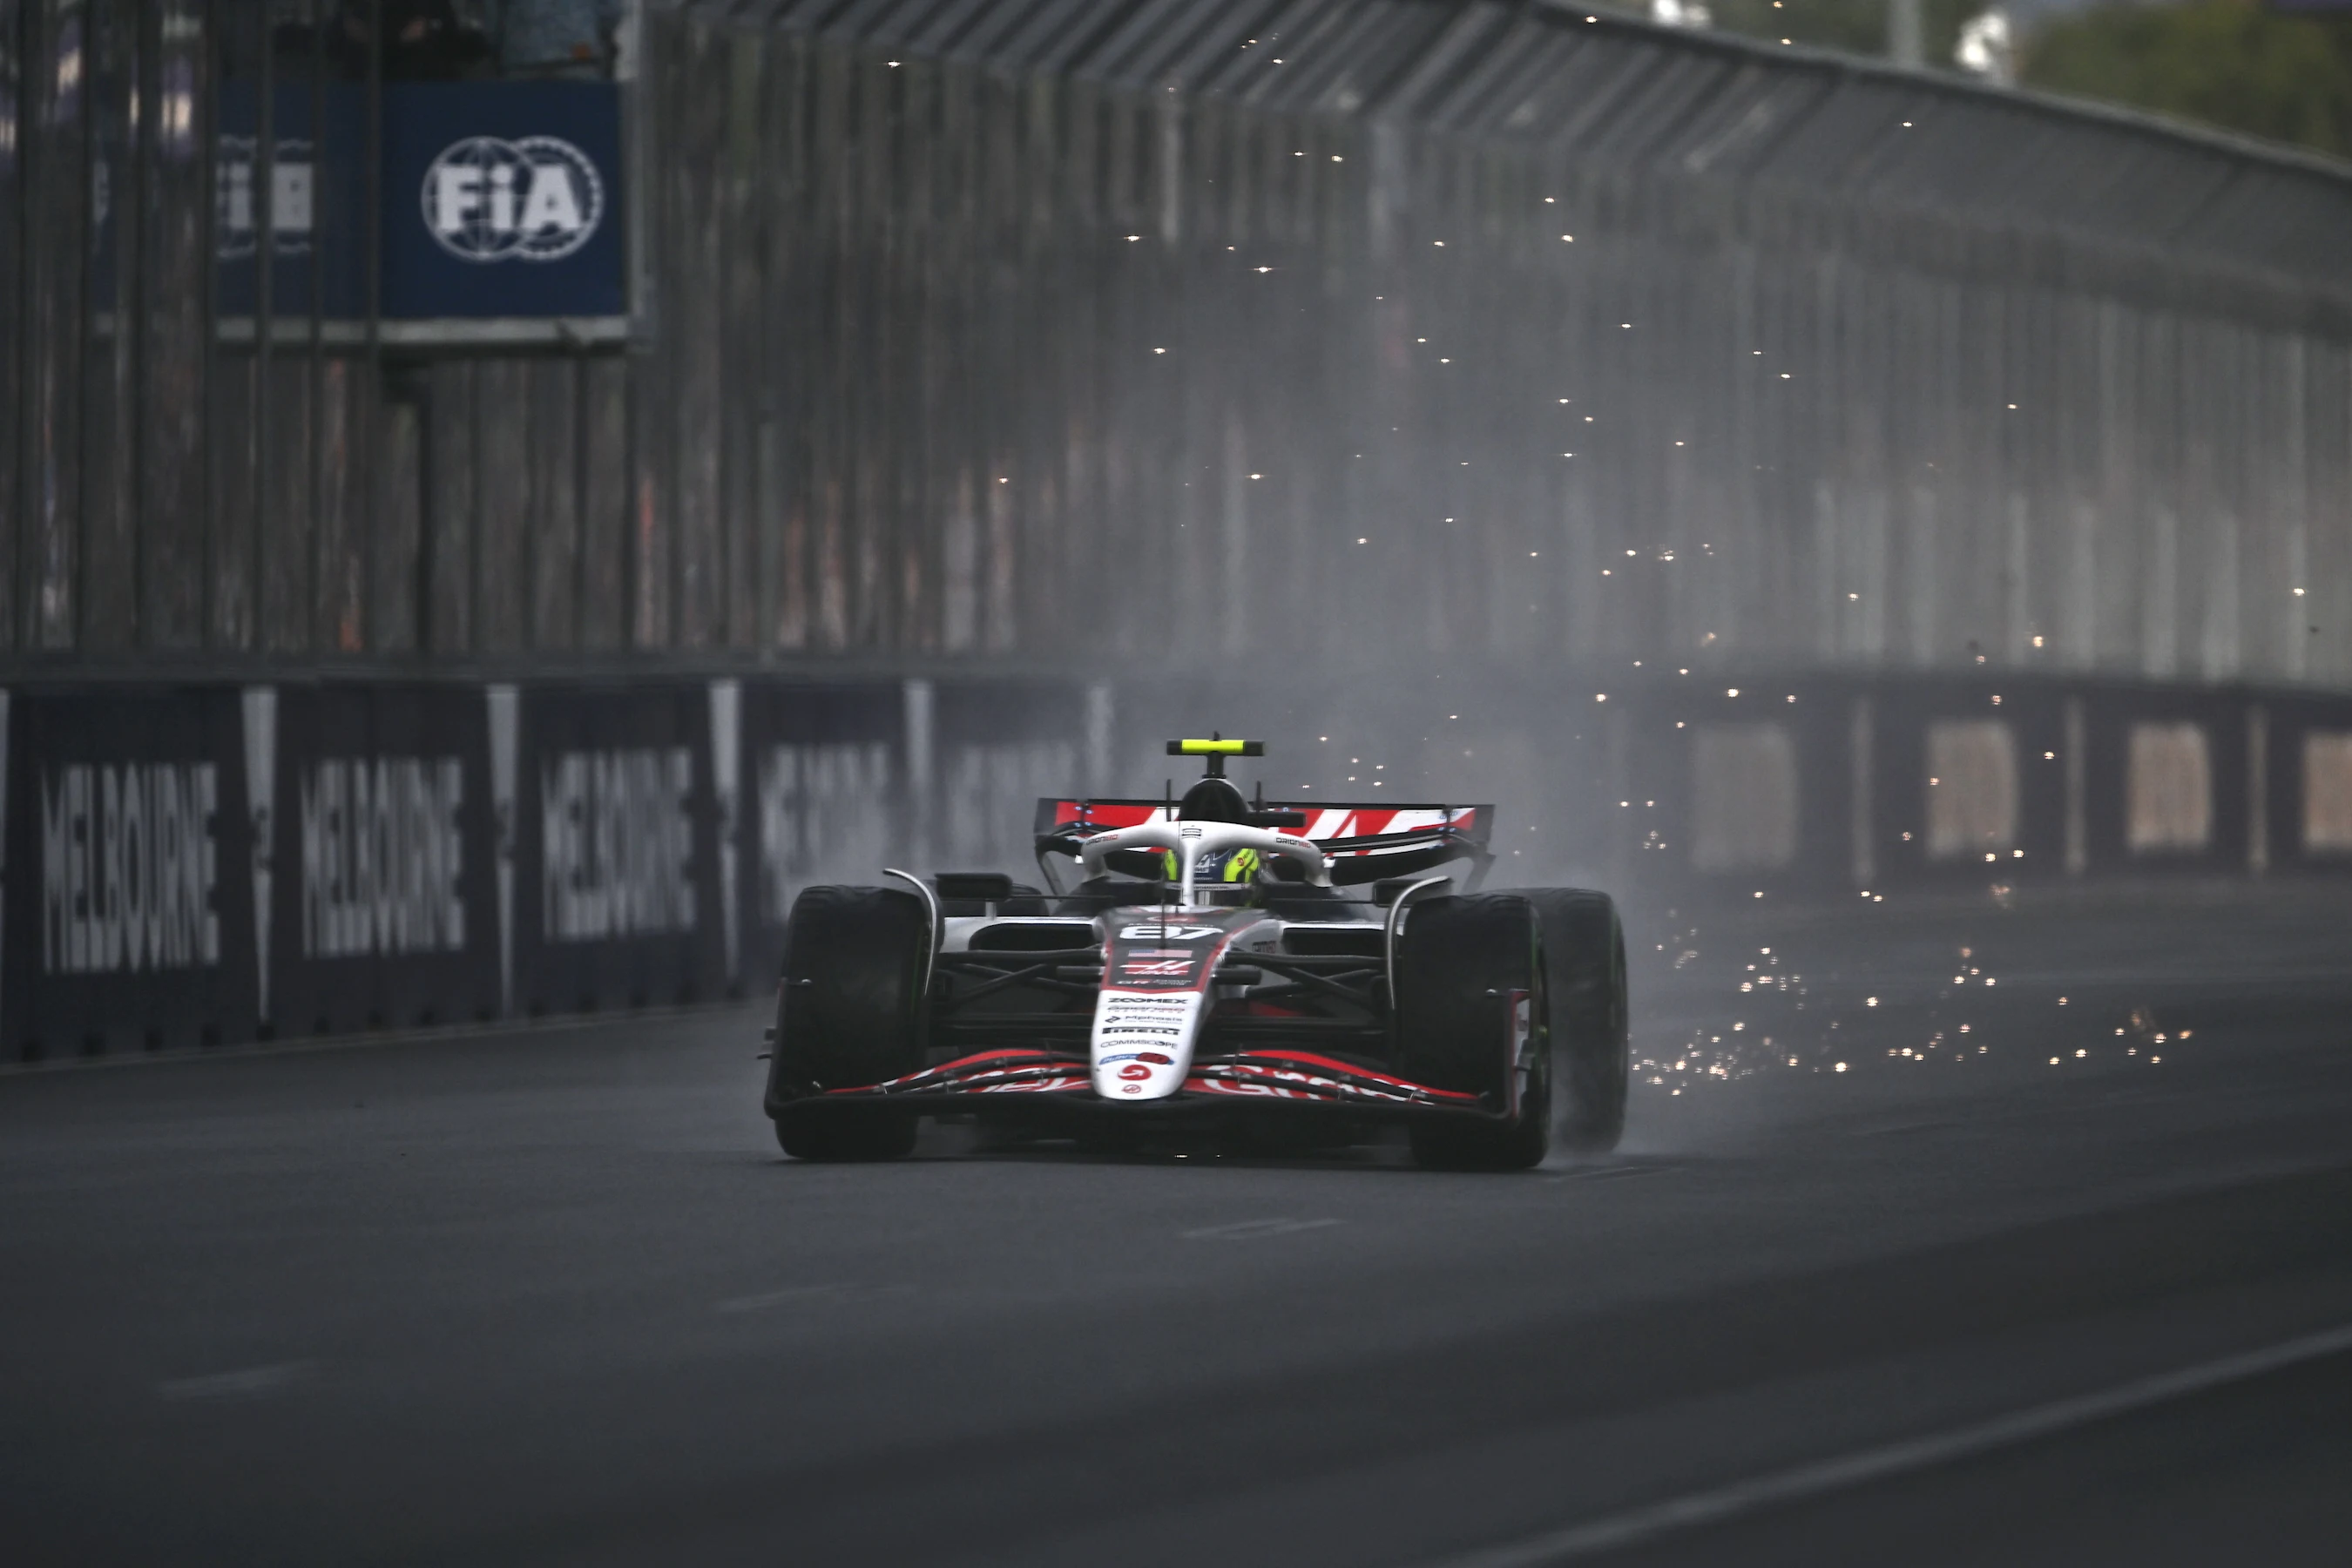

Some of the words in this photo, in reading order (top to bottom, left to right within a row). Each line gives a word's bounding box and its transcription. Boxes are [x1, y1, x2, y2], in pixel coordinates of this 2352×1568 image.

[44, 760, 219, 974] MELBOURNE
[1119, 925, 1224, 940] 87
[1102, 1026, 1180, 1036] PIRELLI
[1100, 1039, 1178, 1050] COMMSCOPE
